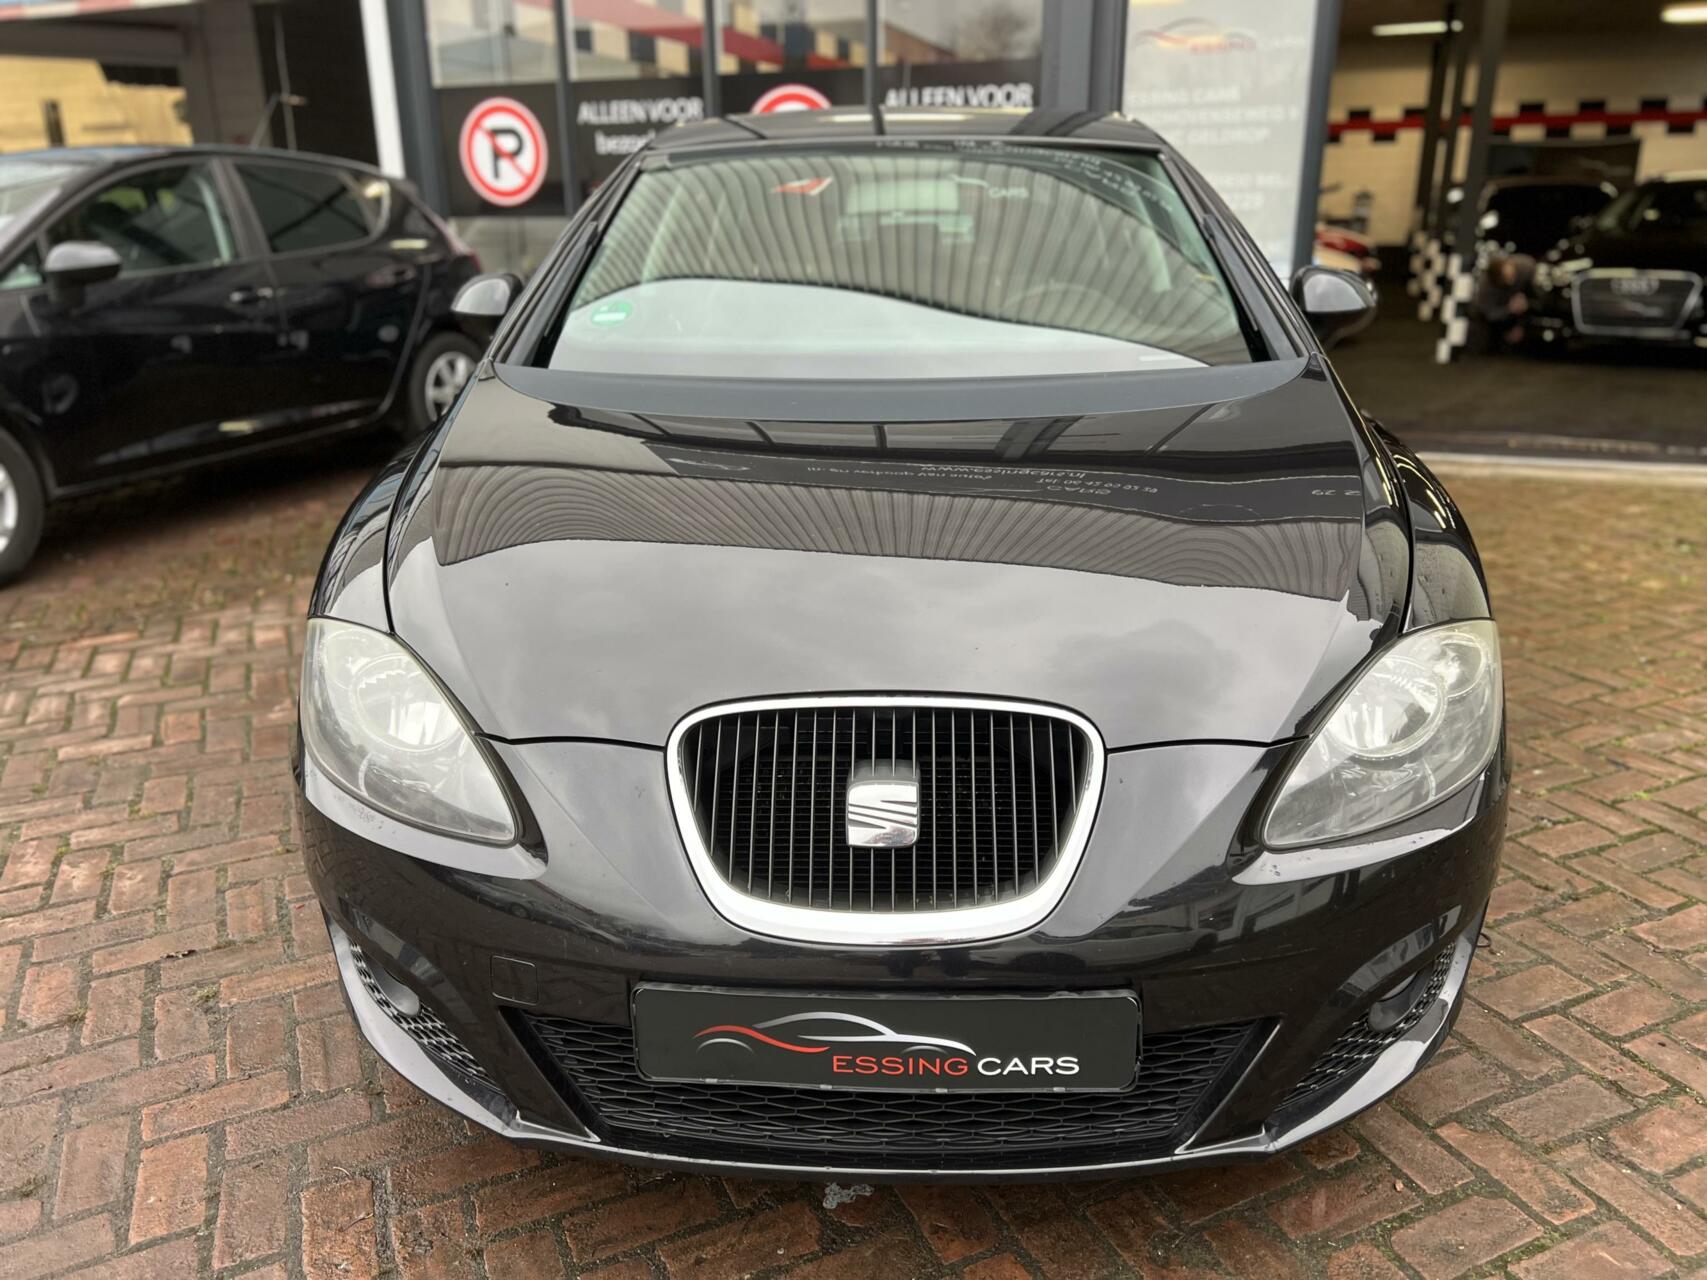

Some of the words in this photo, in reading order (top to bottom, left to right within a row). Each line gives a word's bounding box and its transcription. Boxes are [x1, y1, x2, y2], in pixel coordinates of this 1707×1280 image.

[883, 87, 965, 106] ALLEEN
[966, 83, 1033, 106] VOOR
[576, 100, 648, 125] ALLEEN
[646, 96, 704, 122] VOOR
[833, 1055, 968, 1075] ESSING
[977, 1056, 1080, 1076] CARS
